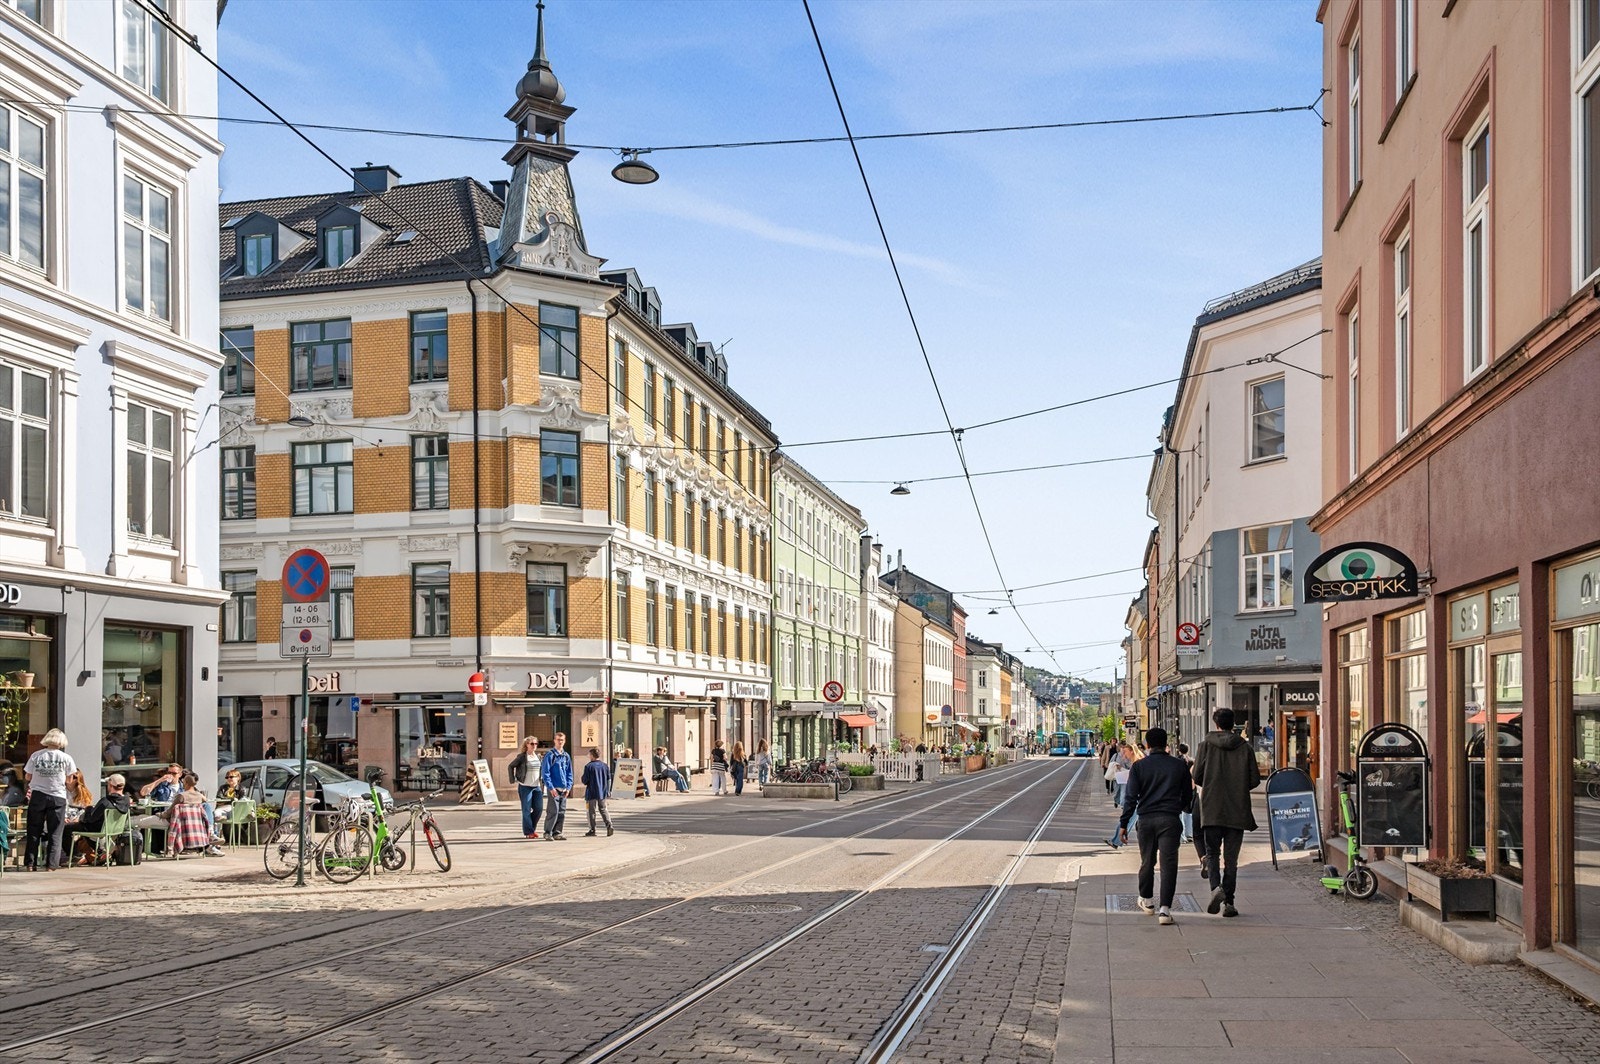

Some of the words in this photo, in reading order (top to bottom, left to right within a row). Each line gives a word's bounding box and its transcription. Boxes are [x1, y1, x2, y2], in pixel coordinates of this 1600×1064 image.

[293, 615, 319, 624] (12-06)
[1250, 624, 1280, 639] PÜTA
[1245, 638, 1286, 651] MADRE
[290, 645, 309, 654] Øvrig
[528, 669, 570, 690] Deli
[1285, 692, 1315, 701] POLLO
[1274, 807, 1311, 815] NYHETENE
